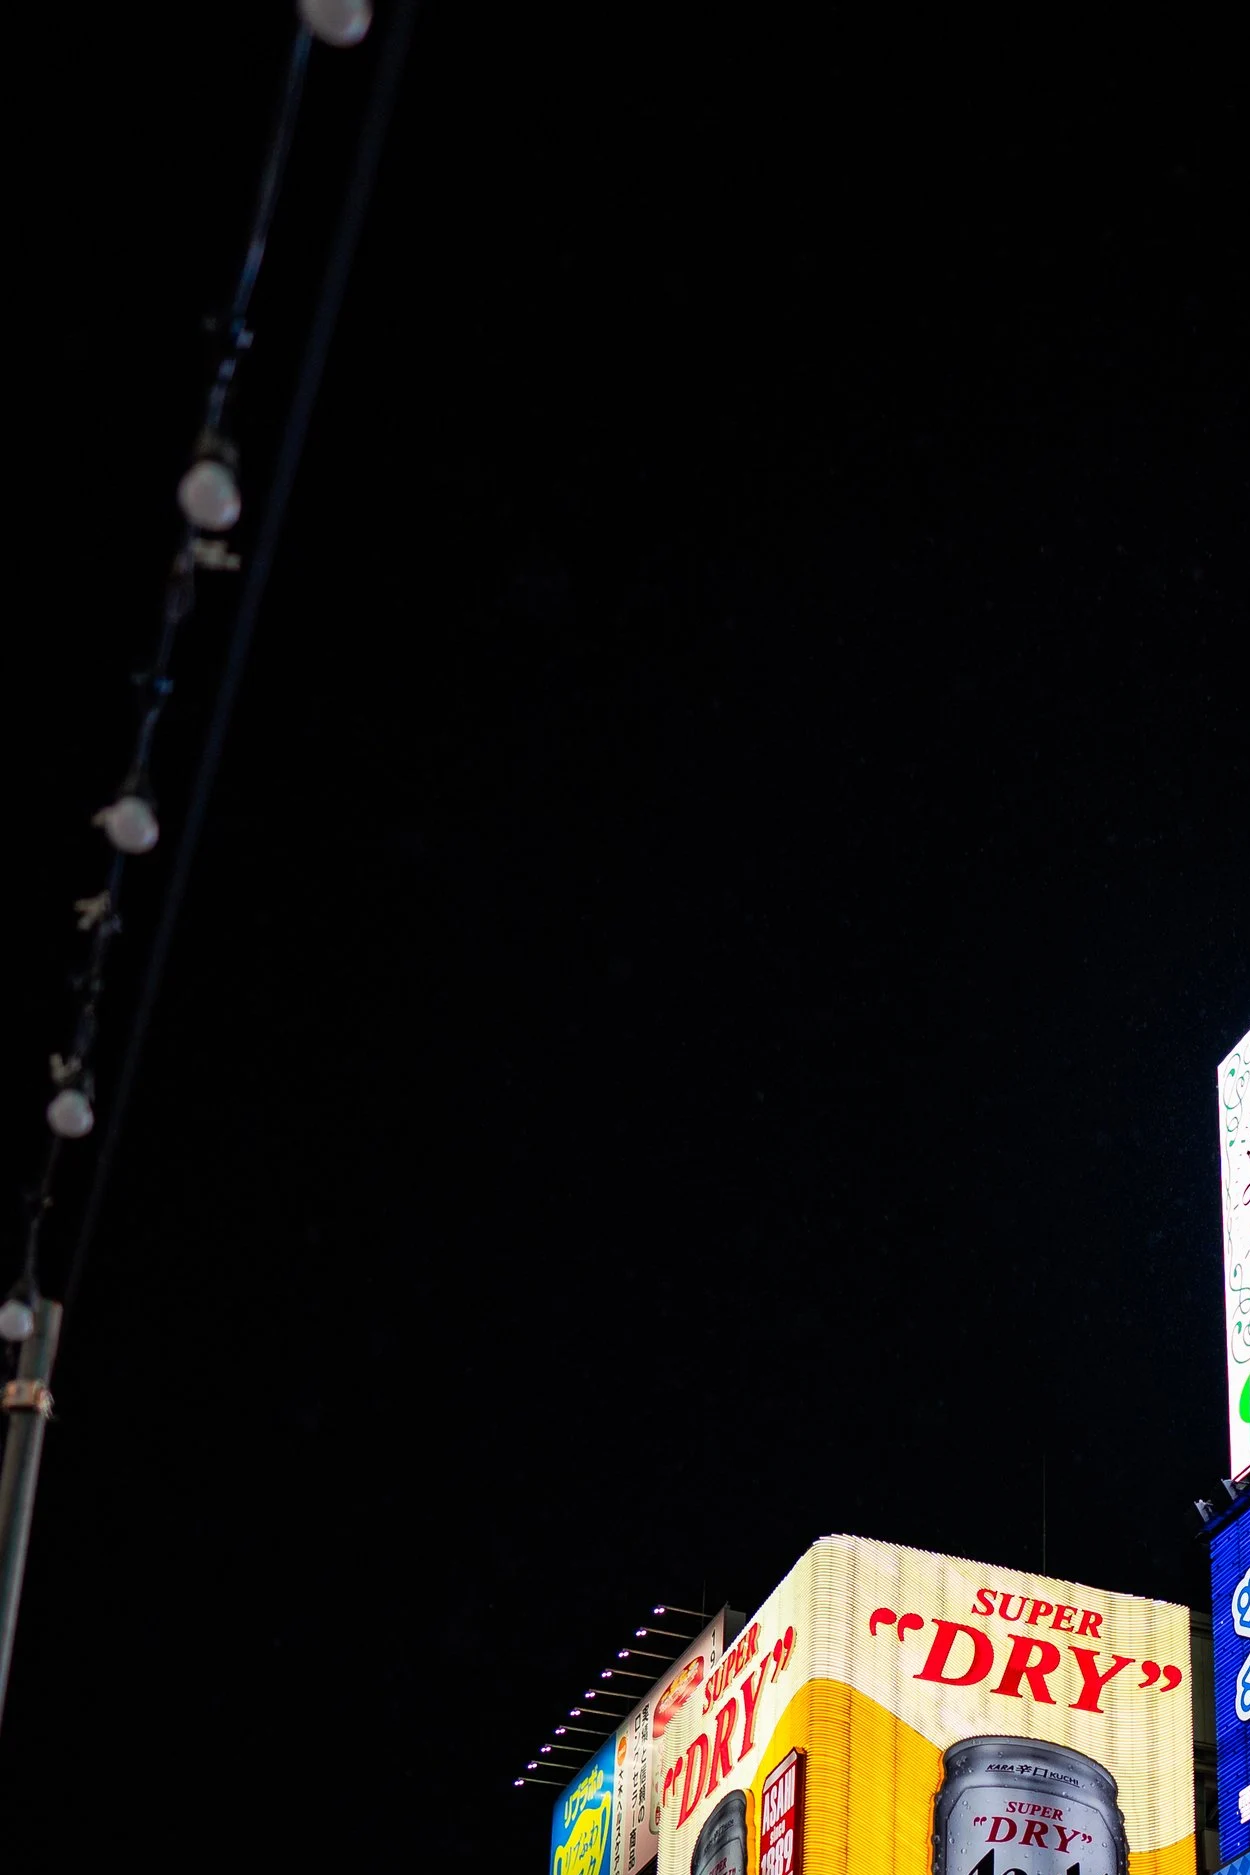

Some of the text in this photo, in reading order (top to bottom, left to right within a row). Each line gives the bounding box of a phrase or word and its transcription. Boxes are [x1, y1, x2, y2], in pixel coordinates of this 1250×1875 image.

[970, 1587, 1103, 1640] SUPER
[701, 1621, 761, 1716] SUPER
[762, 1763, 795, 1837] ASAHI
[986, 1763, 1080, 1786] KARA 辛口 KUCHI
[1006, 1801, 1063, 1821] SUPER
